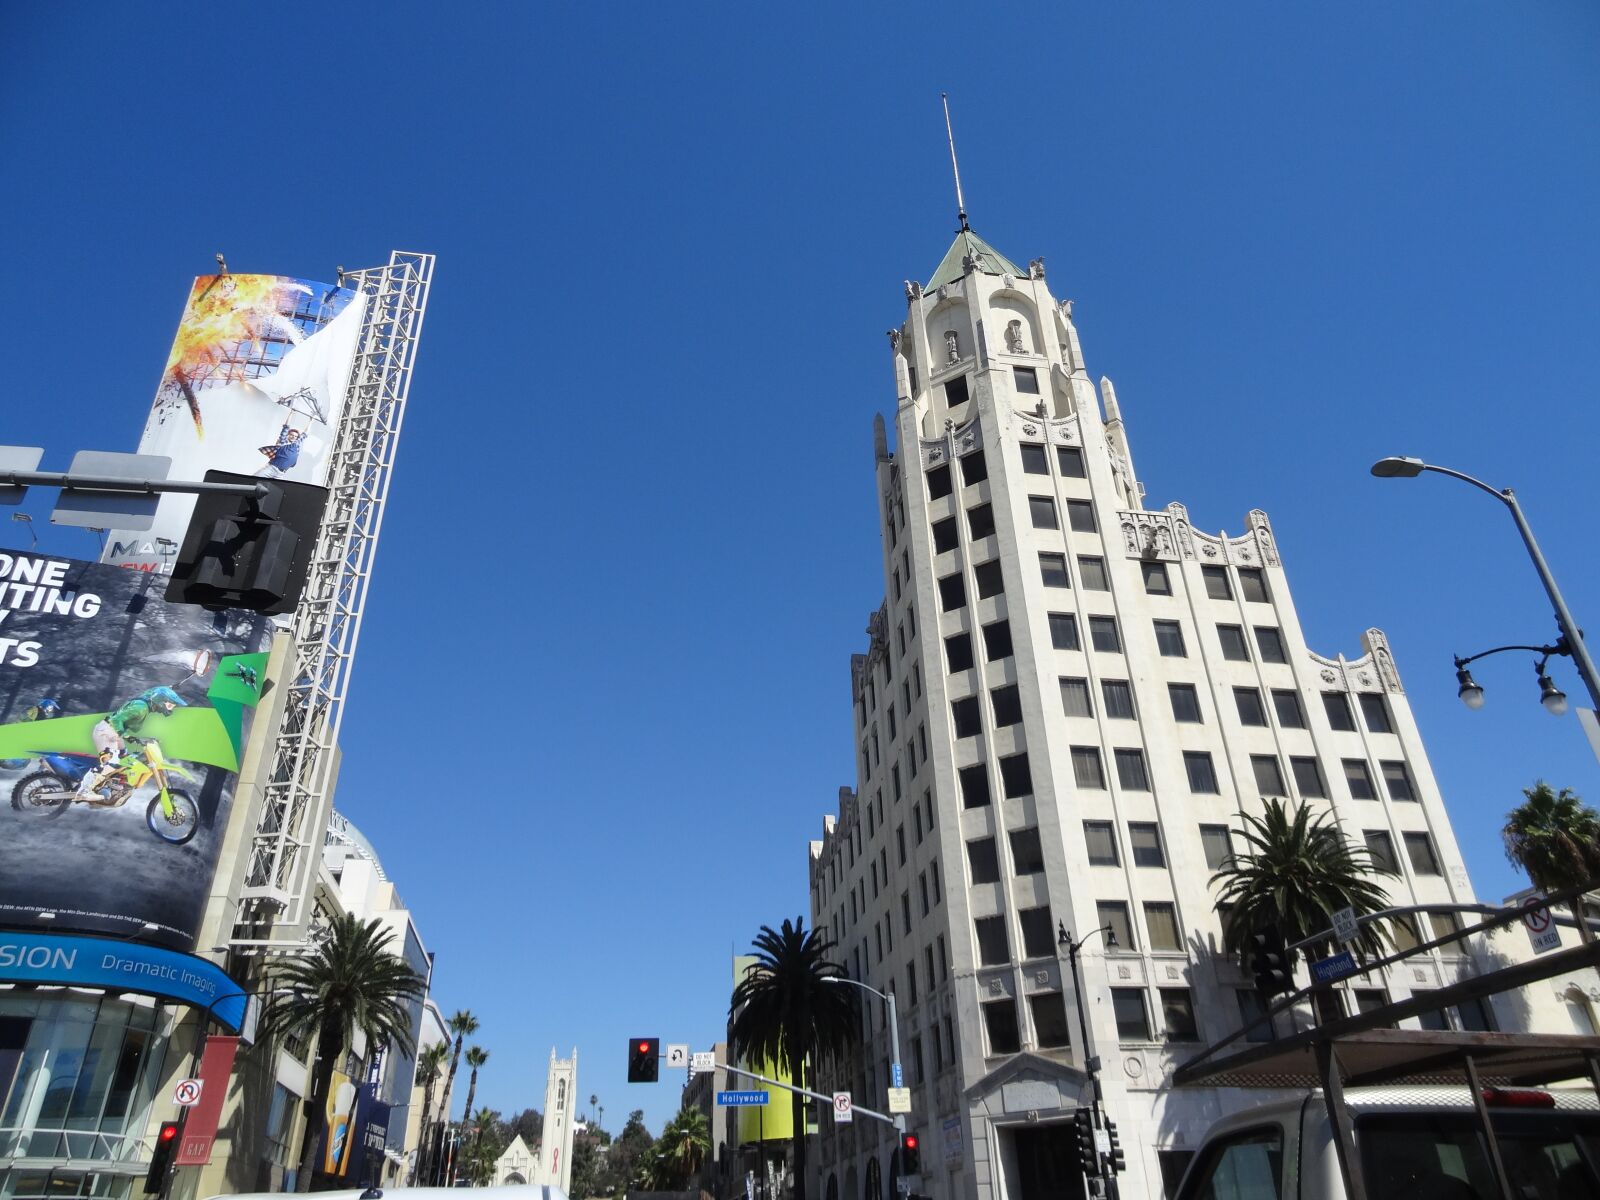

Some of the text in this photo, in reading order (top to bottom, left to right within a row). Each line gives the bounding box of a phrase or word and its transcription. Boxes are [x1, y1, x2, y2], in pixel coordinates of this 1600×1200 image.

[1534, 932, 1557, 948] ON RED
[0, 945, 217, 997] SION Dramatic Imaging
[1317, 957, 1353, 979] Highland
[722, 1094, 764, 1104] Hollywood
[187, 1143, 205, 1156] GAP
